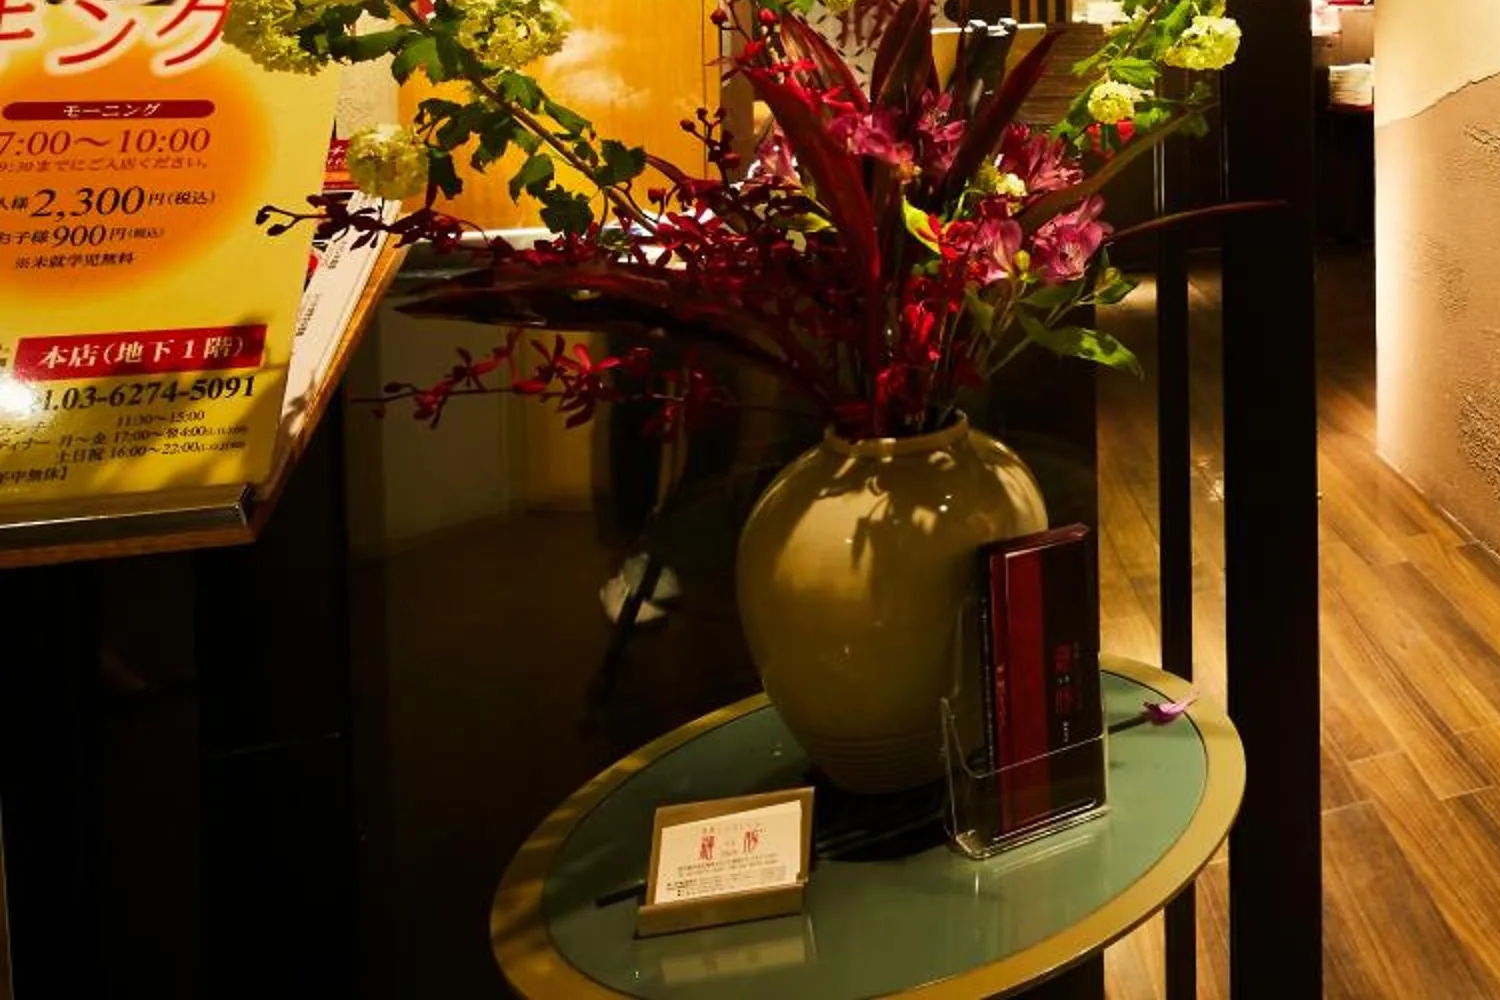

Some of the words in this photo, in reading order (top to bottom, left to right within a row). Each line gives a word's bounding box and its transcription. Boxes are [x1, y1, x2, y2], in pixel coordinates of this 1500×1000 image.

[64, 103, 160, 117] モーニング
